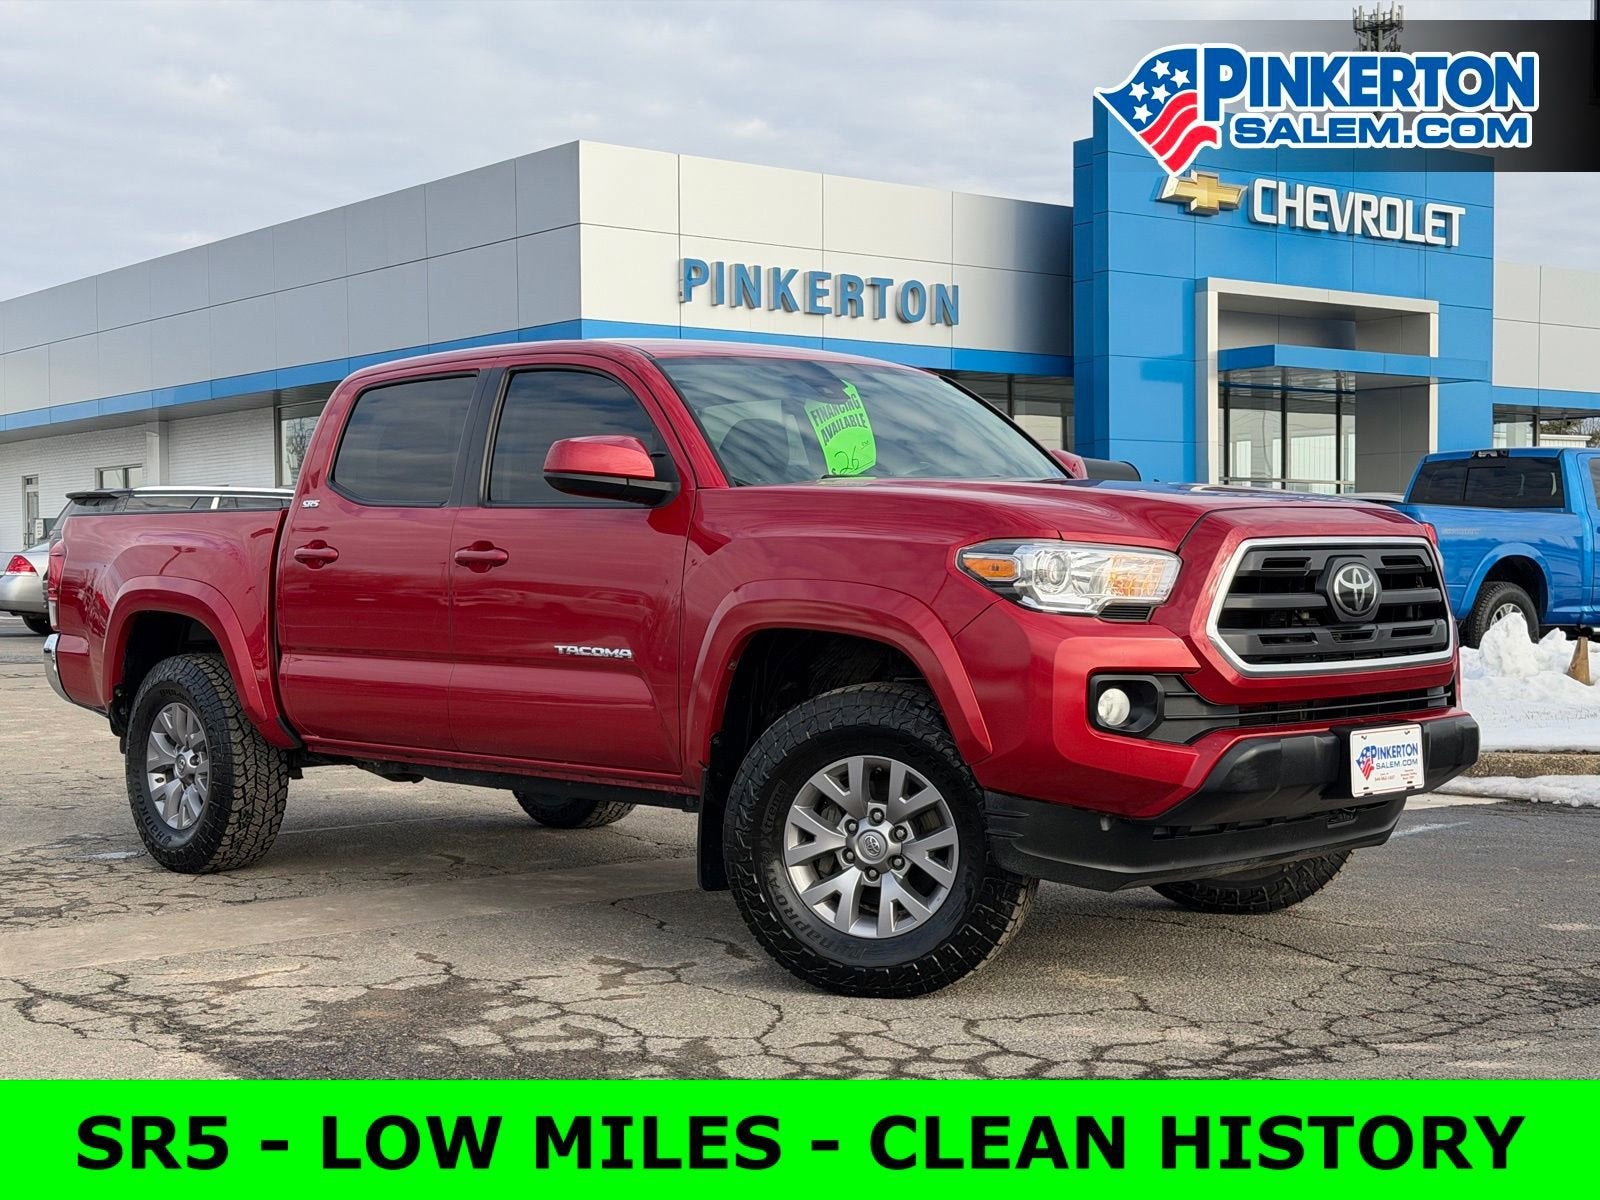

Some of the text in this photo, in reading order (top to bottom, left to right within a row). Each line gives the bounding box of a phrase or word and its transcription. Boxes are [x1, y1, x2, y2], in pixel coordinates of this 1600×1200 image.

[1252, 177, 1466, 248] CHEVROLET
[680, 257, 959, 326] PINKERTON
[810, 393, 862, 426] FINANCING
[820, 412, 869, 446] AVAILABLE
[553, 645, 633, 659] TACOMA
[1370, 742, 1419, 764] PINKERTON
[1375, 757, 1419, 770] SALEM.COM
